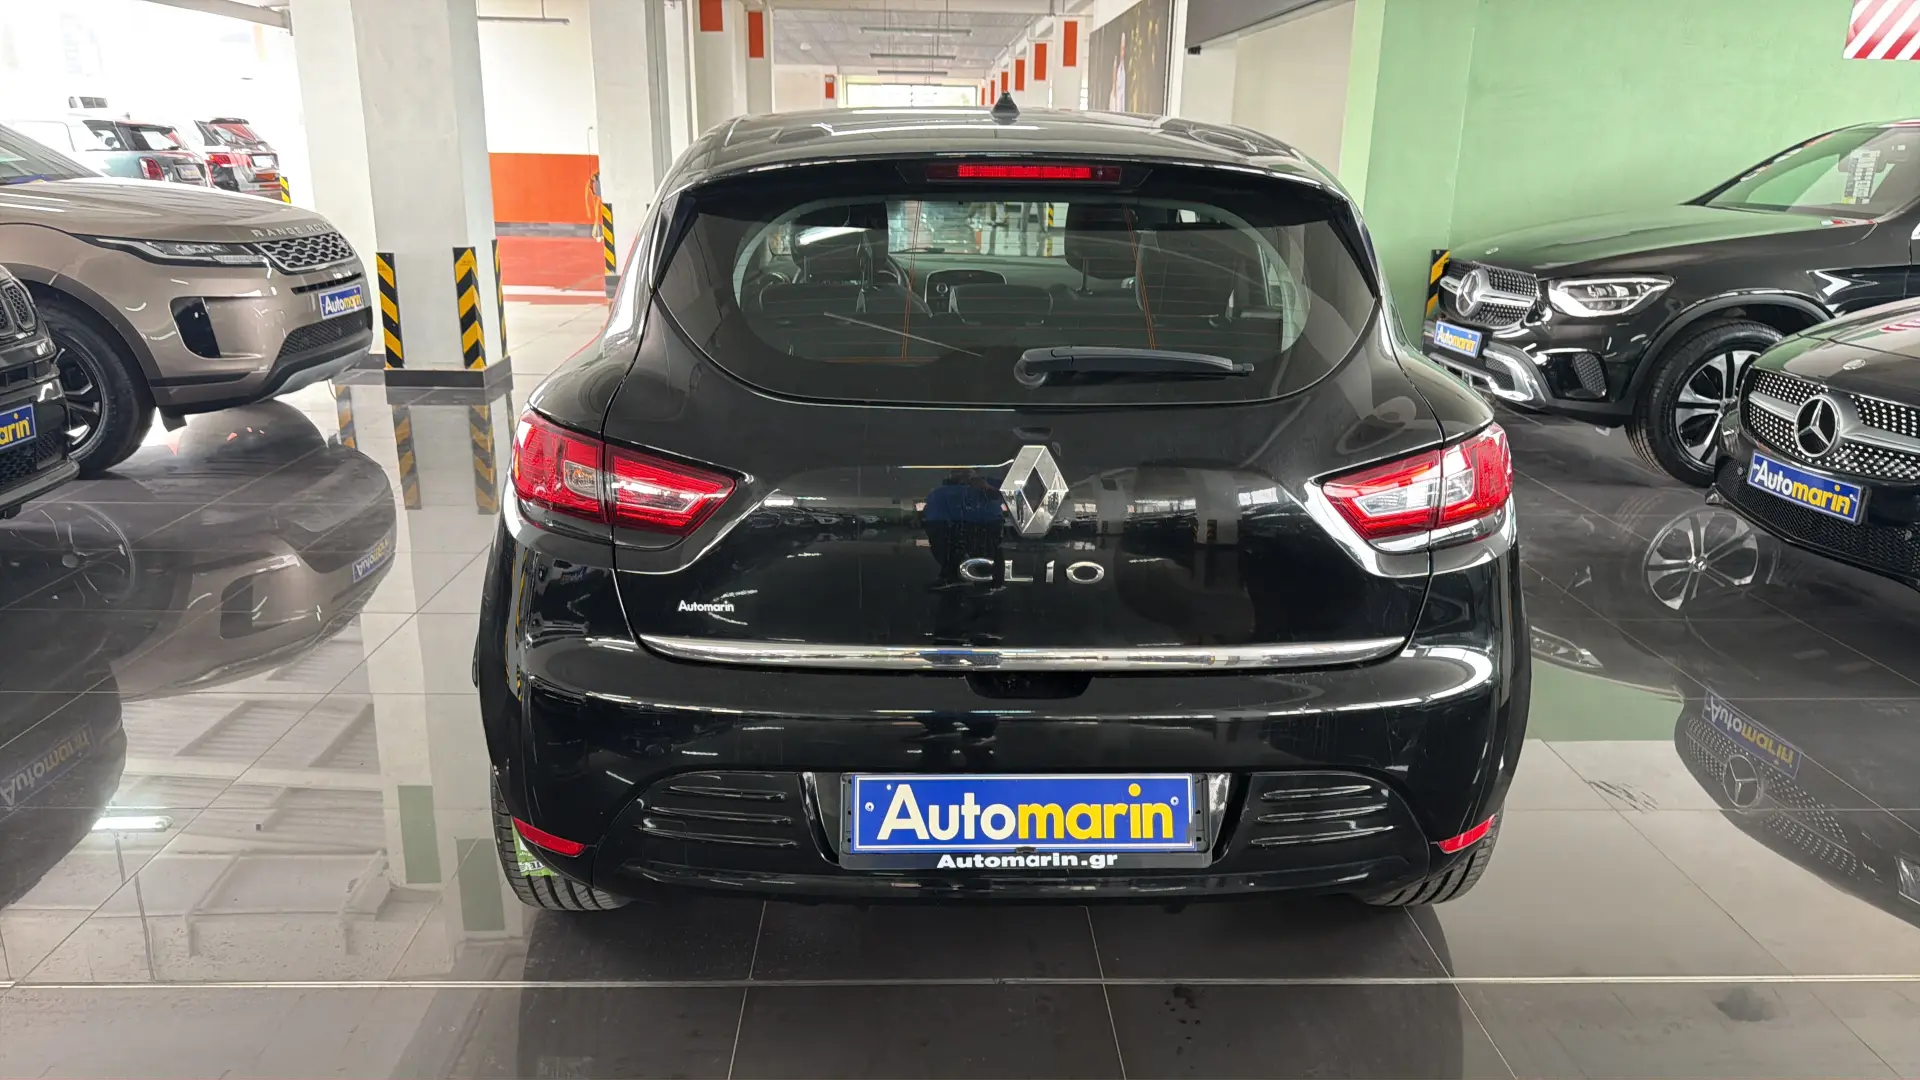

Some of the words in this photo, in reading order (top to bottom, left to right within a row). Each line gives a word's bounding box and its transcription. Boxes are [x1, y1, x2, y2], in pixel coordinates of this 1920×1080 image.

[250, 226, 303, 238] RANGE
[1754, 460, 1851, 515] Automarin
[959, 557, 1105, 584] CLIO
[678, 600, 735, 612] Automarin
[876, 783, 1174, 841] Automarin
[936, 852, 1118, 869] Automarin.gr
